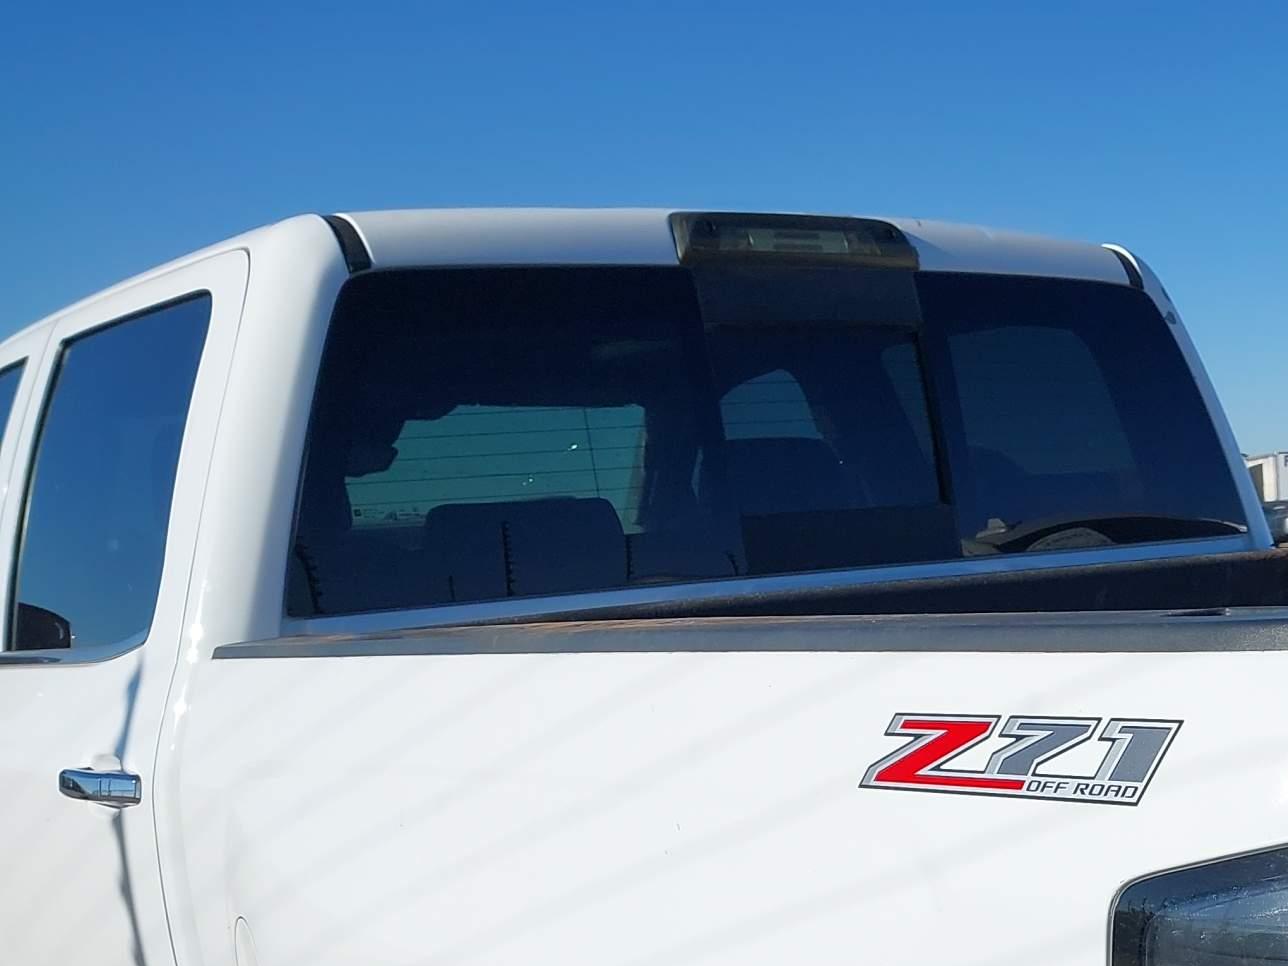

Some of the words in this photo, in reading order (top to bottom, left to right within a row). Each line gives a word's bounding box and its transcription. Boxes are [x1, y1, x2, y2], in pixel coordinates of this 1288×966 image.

[859, 712, 1183, 804] Z71
[1026, 780, 1069, 793] OFF
[1072, 783, 1139, 798] ROAD
